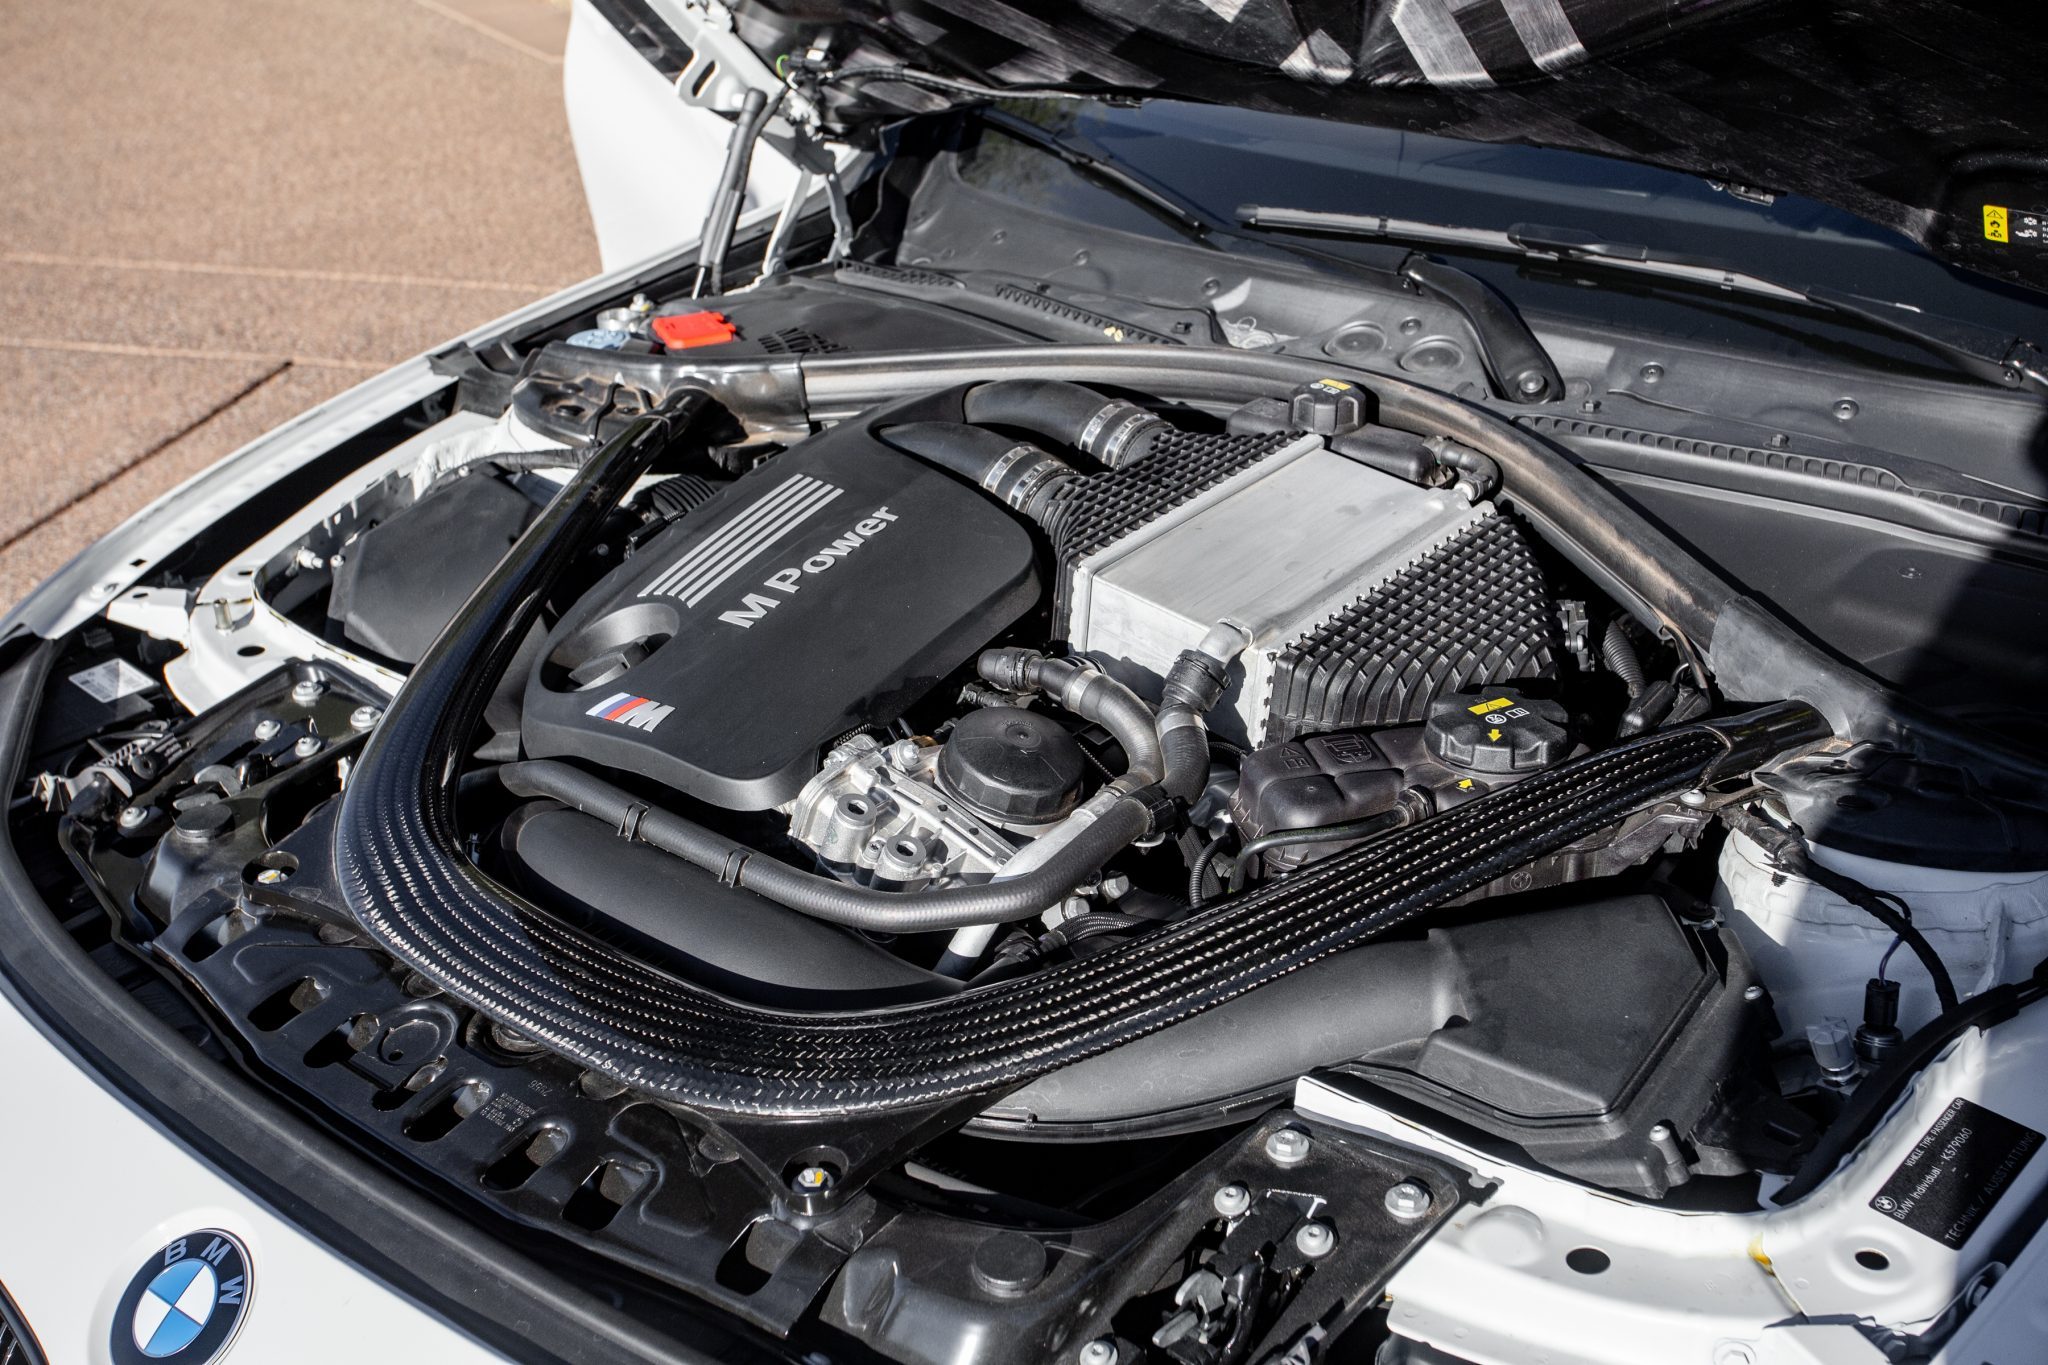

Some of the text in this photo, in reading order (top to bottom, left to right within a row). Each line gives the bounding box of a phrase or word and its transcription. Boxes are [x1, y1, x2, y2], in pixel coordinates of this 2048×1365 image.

[717, 505, 899, 629] M Power
[1904, 1147, 1925, 1168] VEHICLE
[1931, 1107, 1957, 1136] PASSENGER
[1952, 1098, 1966, 1111] CAR
[1893, 1198, 1915, 1220] BMW
[1910, 1165, 1942, 1200] Individual
[1944, 1203, 1978, 1242] TECHNIK
[1983, 1131, 2038, 1196] AUSSTATTUNG
[164, 1236, 244, 1305] BMW
